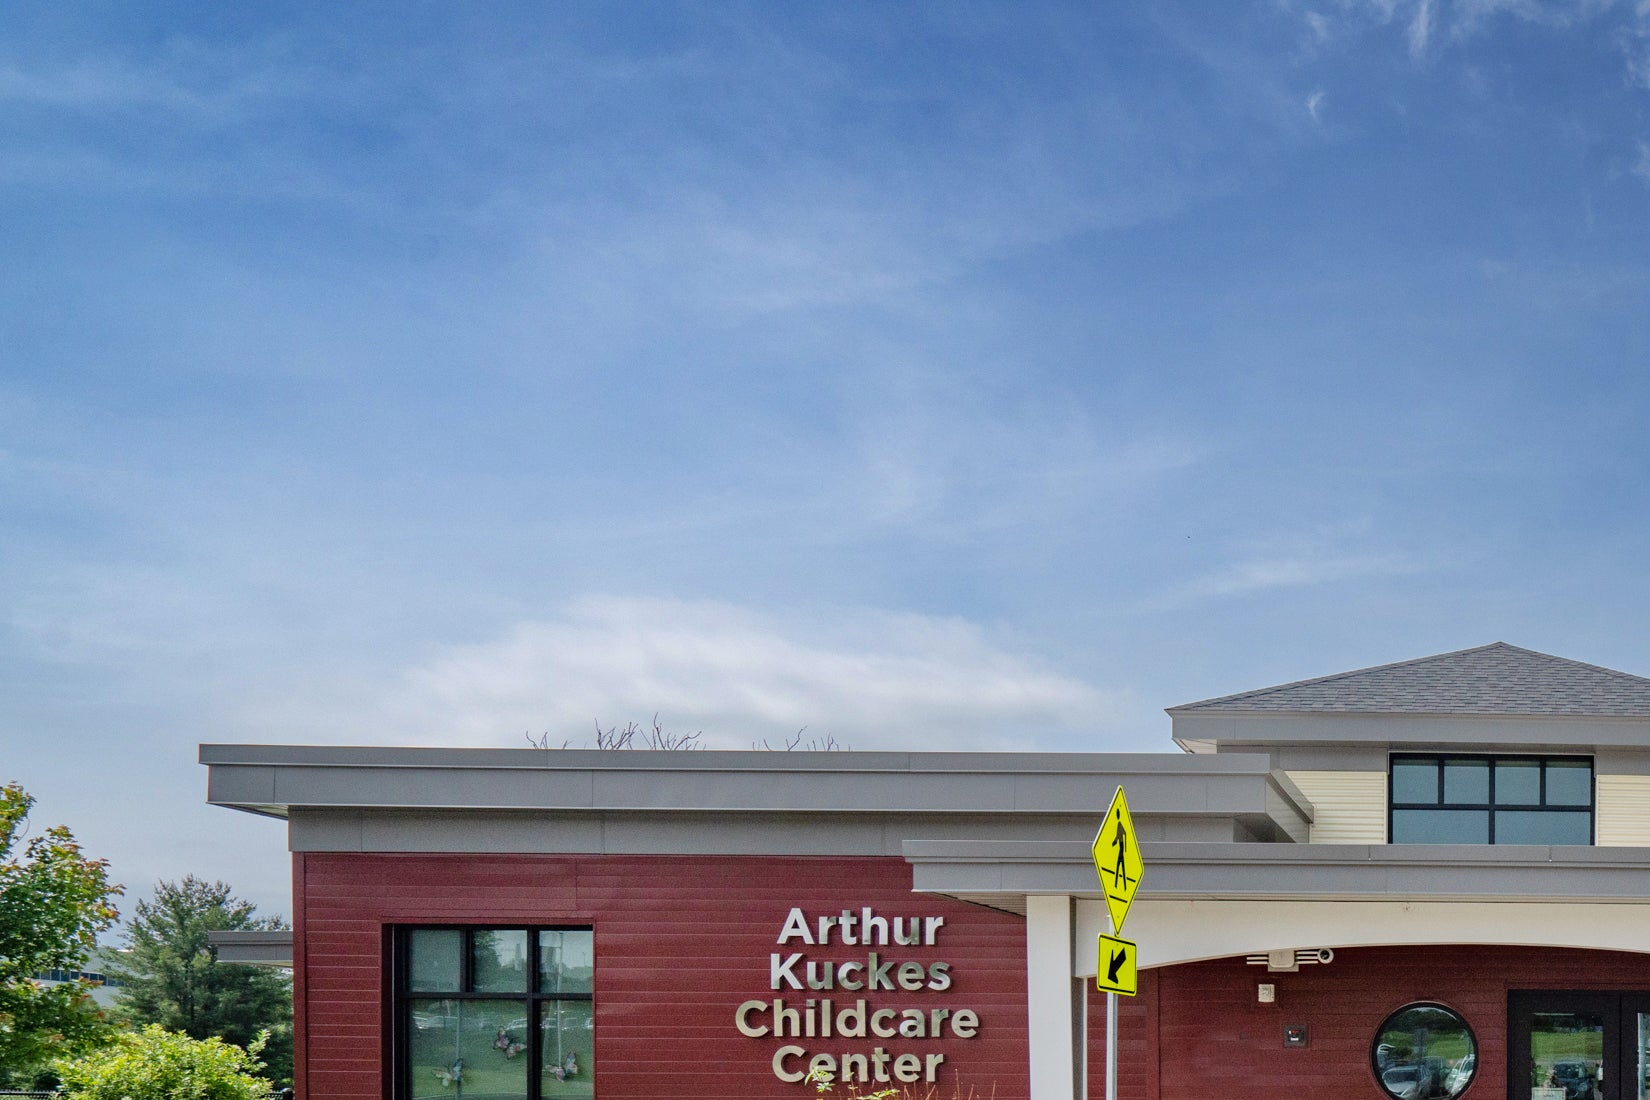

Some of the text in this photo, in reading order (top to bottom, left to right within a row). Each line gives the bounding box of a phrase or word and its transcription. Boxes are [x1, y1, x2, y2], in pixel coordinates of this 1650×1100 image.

[776, 906, 944, 946] Arthur
[769, 951, 951, 991] Kuckes
[734, 998, 980, 1039] Childcare
[771, 1044, 944, 1083] Center
